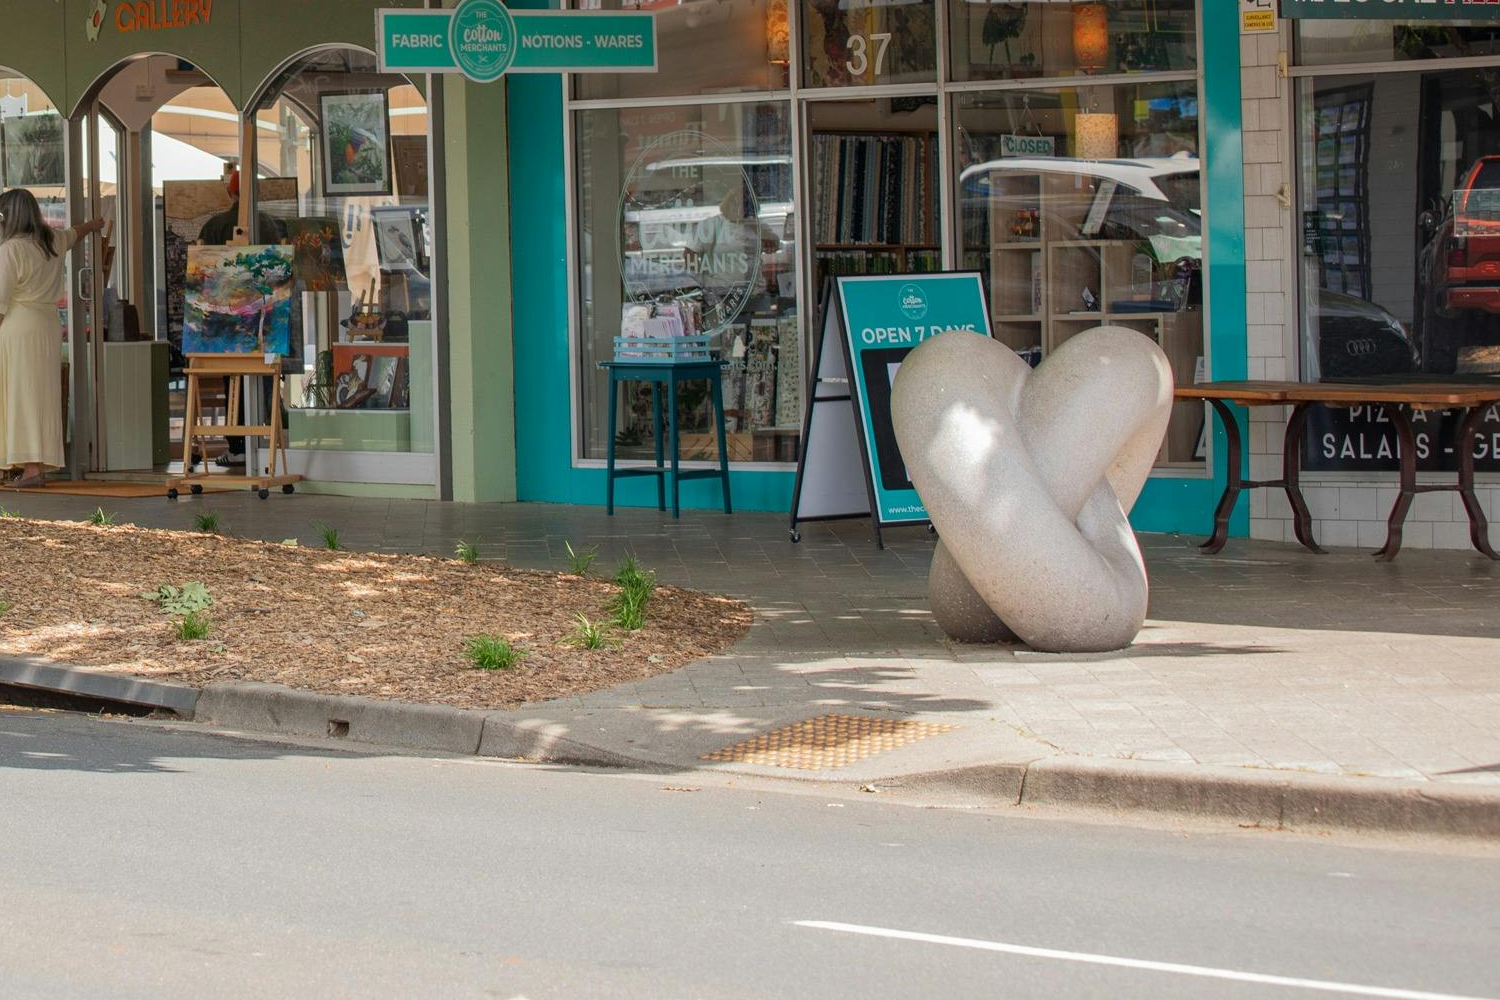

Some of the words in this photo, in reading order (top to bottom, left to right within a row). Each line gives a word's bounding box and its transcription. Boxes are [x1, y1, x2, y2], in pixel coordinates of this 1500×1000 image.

[475, 10, 488, 19] THE
[392, 34, 443, 48] FABRIC
[522, 34, 583, 48] NOTIONS
[594, 34, 643, 48] WARES
[463, 24, 503, 43] cotton
[460, 43, 507, 52] MERCHANTS
[846, 33, 891, 75] 37
[1007, 137, 1052, 154] CLOSED
[630, 253, 749, 274] MERCHANTS
[861, 327, 912, 344] OPEN
[915, 326, 925, 342] 7
[1323, 433, 1430, 460] SALAS
